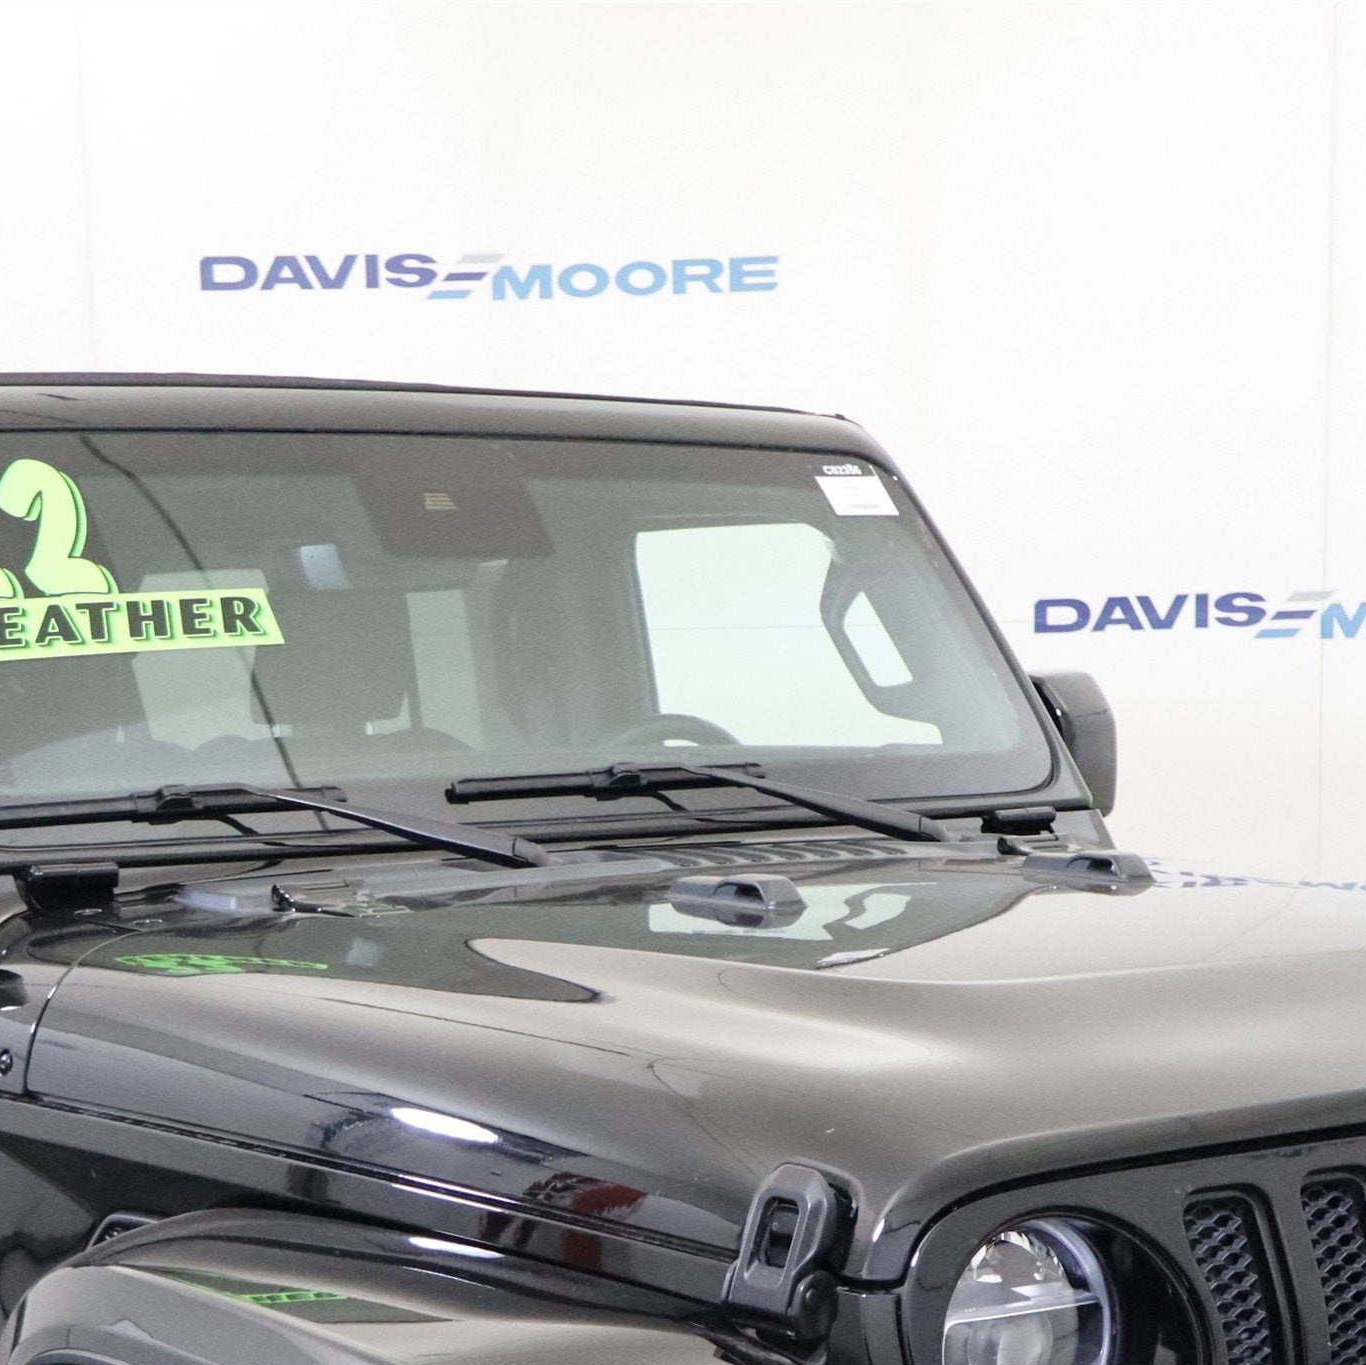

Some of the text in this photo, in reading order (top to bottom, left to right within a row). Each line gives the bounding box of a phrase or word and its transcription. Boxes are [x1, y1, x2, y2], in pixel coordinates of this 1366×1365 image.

[200, 253, 779, 300] DAVIS MOORE
[1035, 592, 1265, 633] DAVIS
